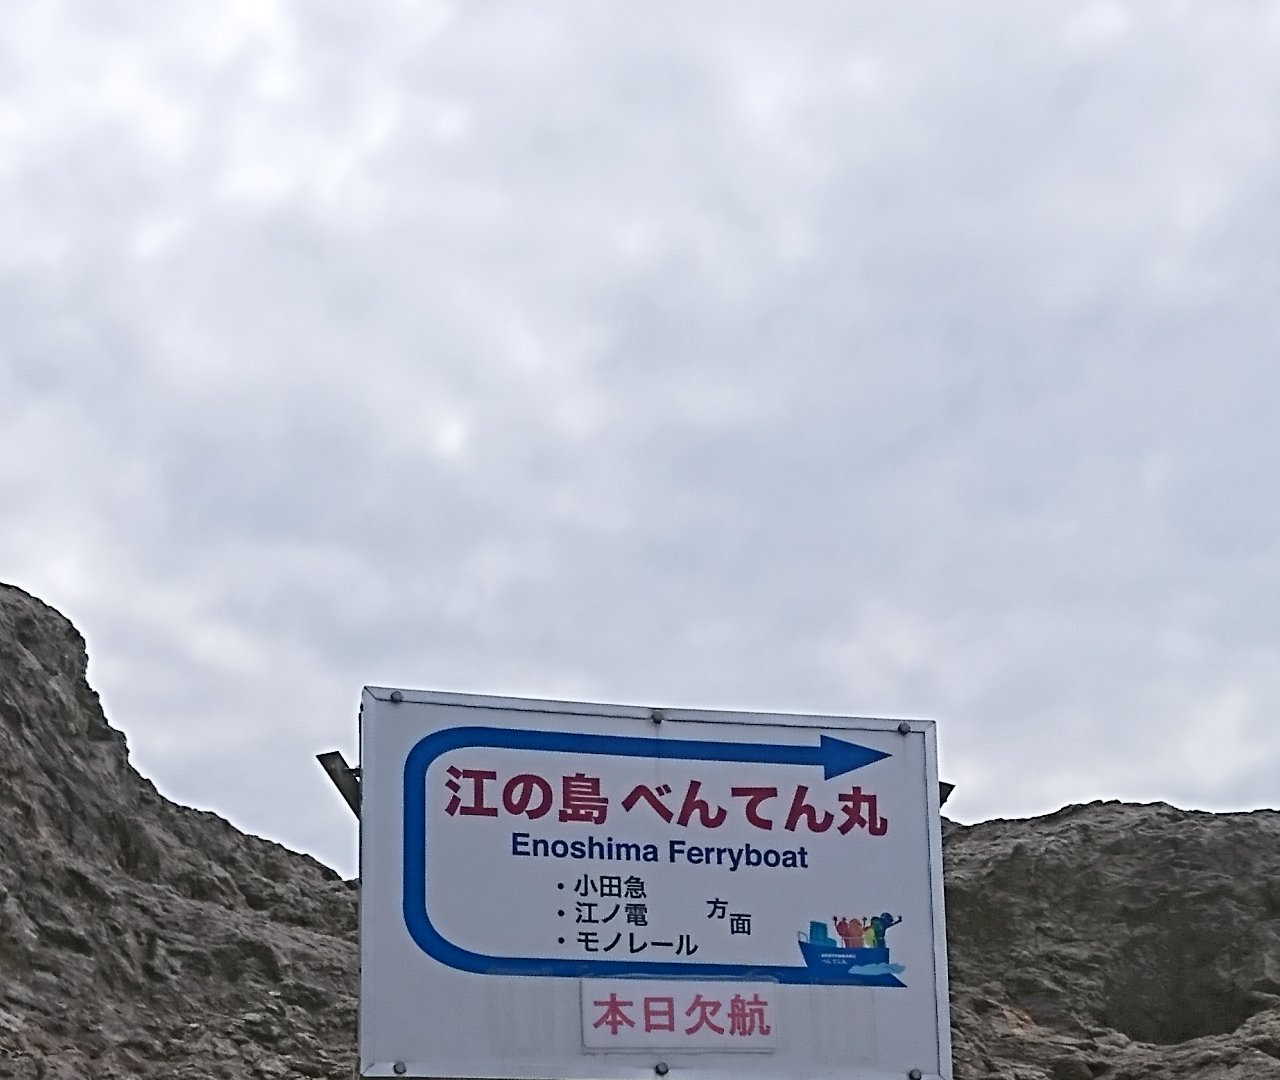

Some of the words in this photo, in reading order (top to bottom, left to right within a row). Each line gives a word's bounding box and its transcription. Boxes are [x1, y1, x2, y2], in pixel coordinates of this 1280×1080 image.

[512, 833, 658, 862] Enoshima
[669, 840, 808, 872] Ferryboat
[592, 993, 771, 1036] 本日欠航
